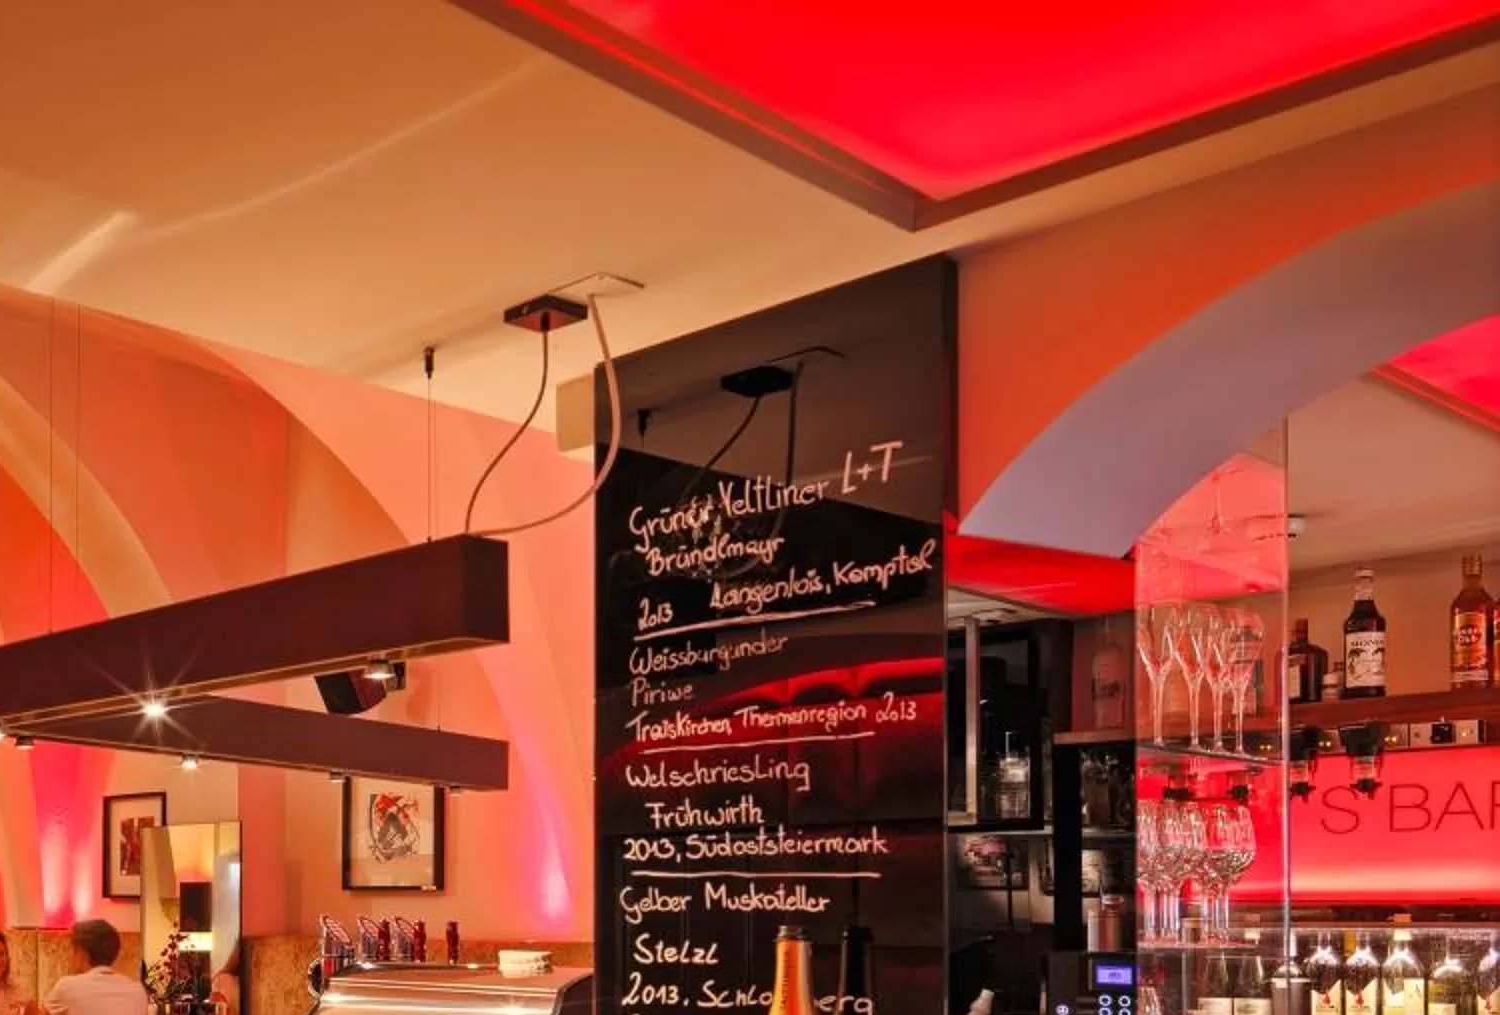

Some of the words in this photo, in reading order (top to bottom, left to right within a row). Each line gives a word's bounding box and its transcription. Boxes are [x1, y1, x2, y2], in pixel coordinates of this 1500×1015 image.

[841, 440, 904, 495] L+T
[645, 532, 785, 577] Bründlmayr
[874, 690, 918, 723] 2013
[644, 793, 765, 830] Frühwirth
[685, 823, 890, 860] Südoststeiermark
[619, 885, 693, 925] Gelber
[704, 880, 831, 913] Muskateller
